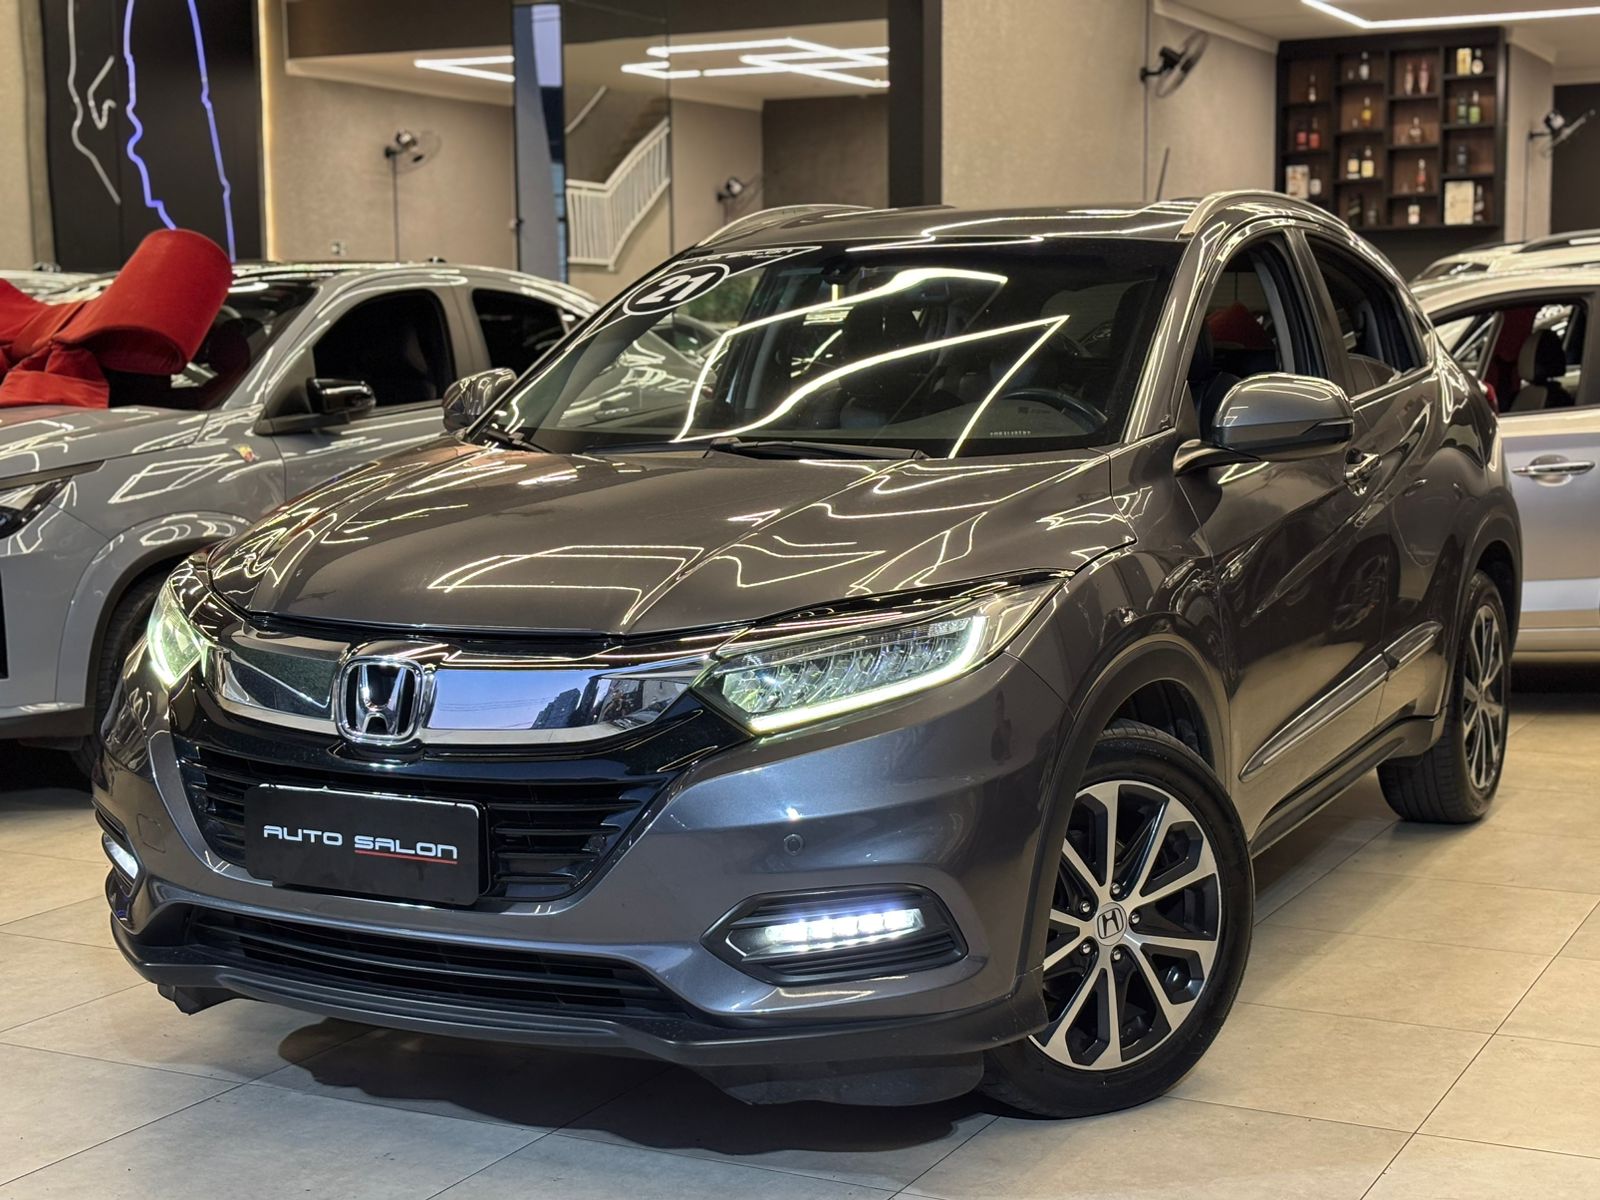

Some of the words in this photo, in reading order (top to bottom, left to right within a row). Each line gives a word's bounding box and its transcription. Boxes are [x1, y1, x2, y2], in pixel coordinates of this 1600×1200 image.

[635, 271, 717, 305] 21
[263, 824, 343, 846] AUTO
[354, 835, 458, 860] SALON
